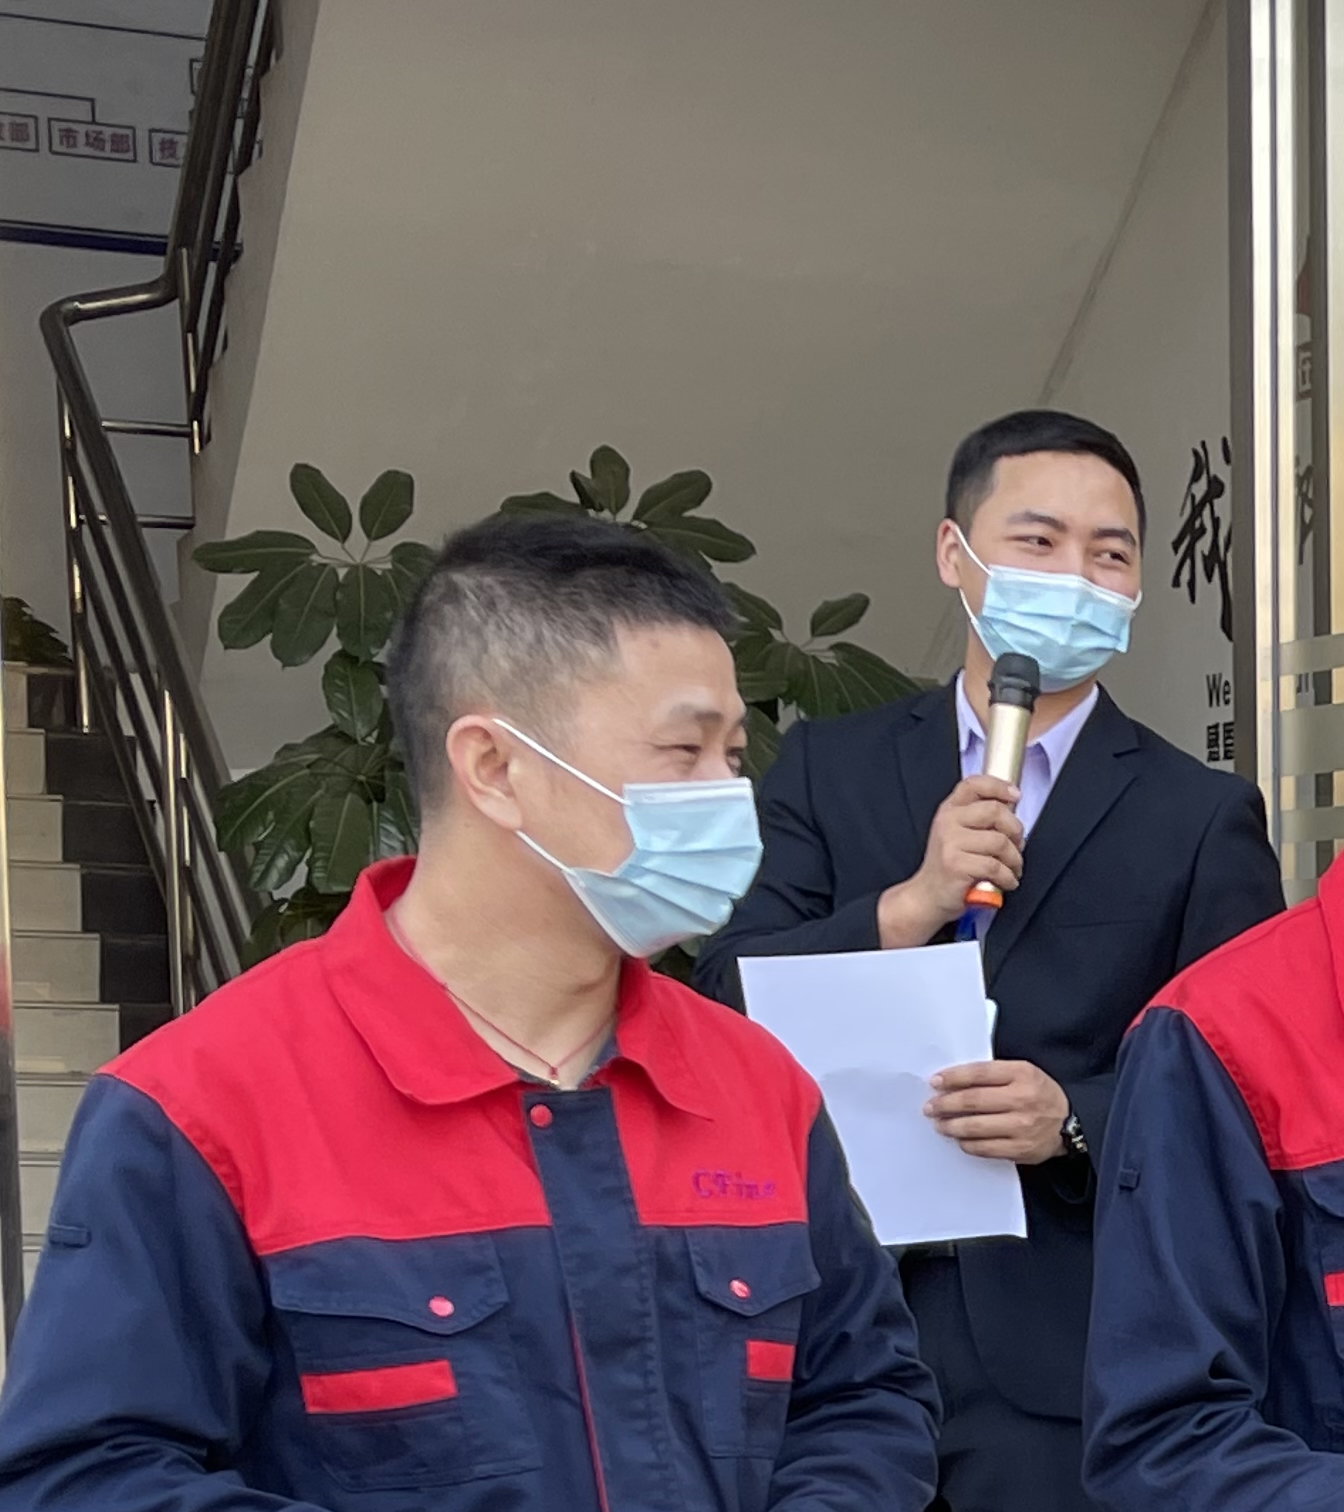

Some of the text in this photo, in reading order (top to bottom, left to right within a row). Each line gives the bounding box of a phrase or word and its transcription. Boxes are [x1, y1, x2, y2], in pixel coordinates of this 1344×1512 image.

[58, 127, 131, 153] 市场部
[1206, 672, 1231, 708] We
